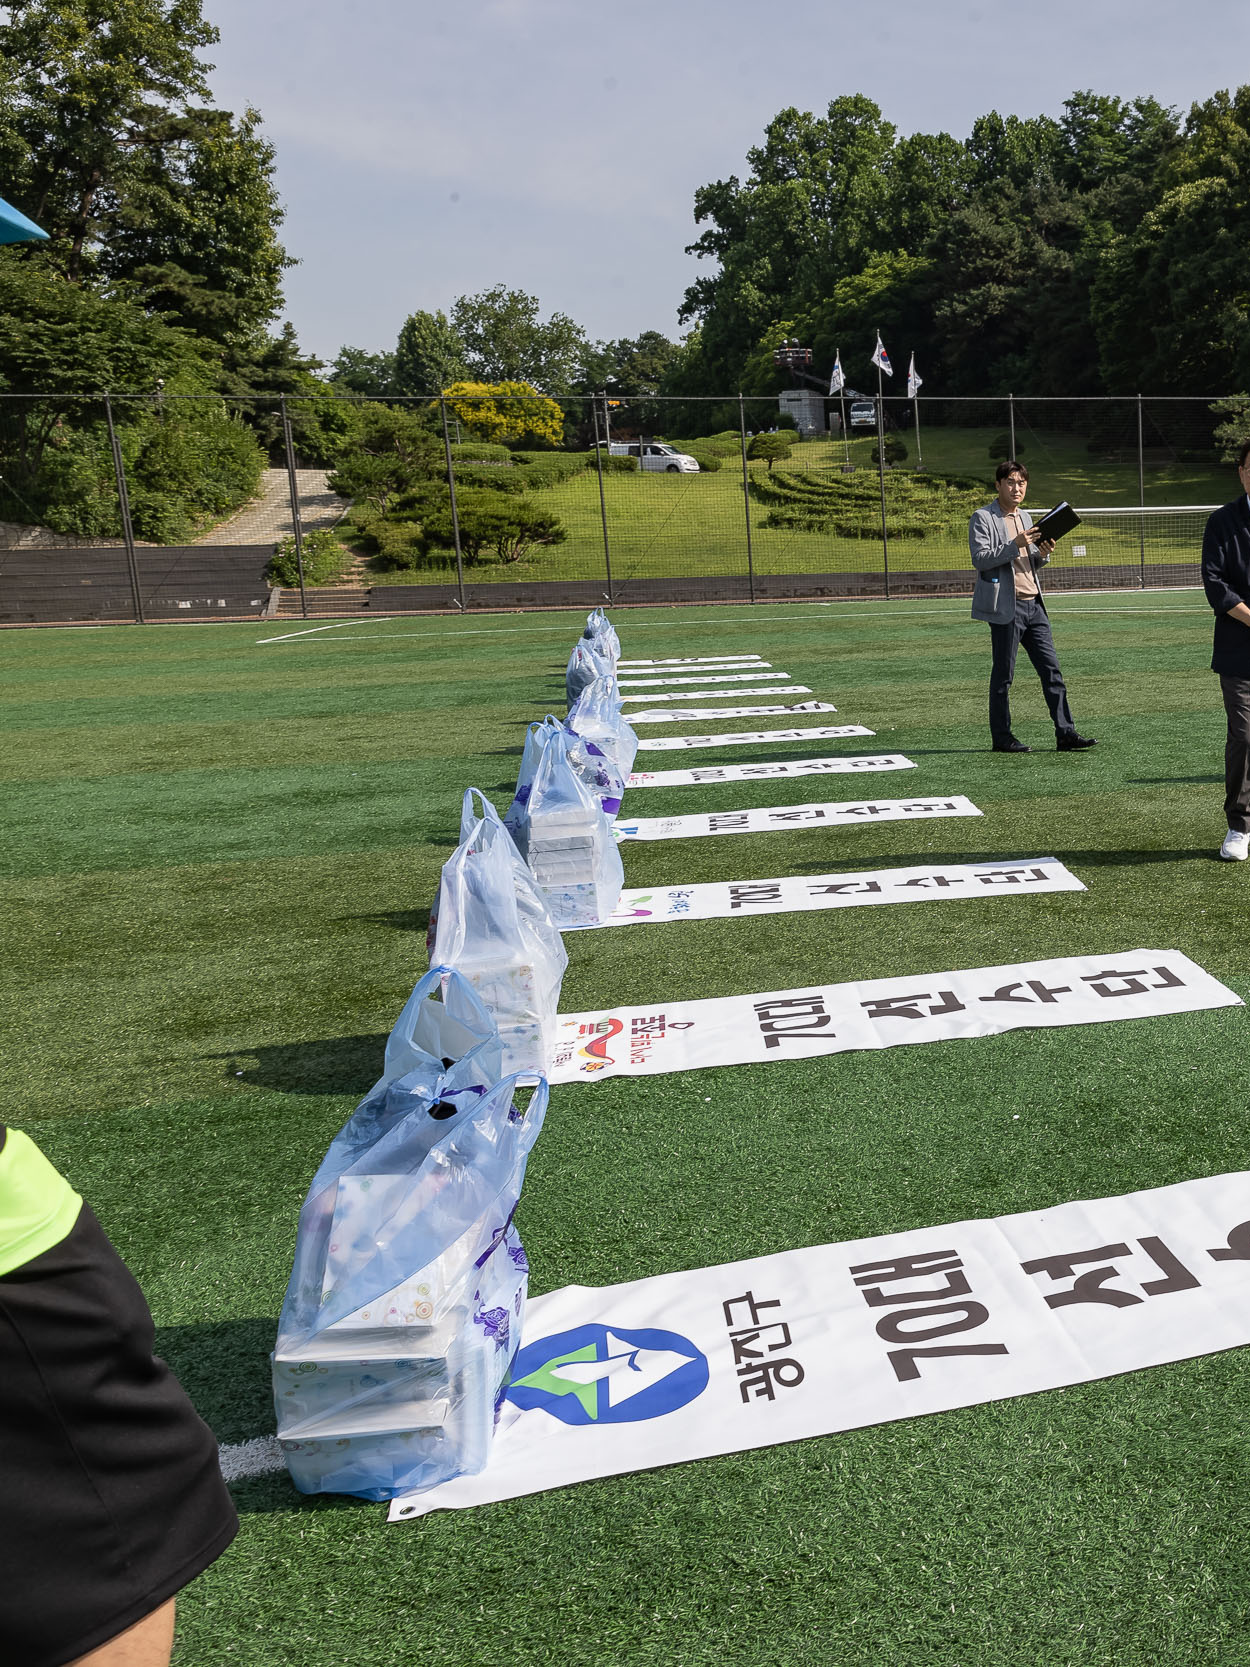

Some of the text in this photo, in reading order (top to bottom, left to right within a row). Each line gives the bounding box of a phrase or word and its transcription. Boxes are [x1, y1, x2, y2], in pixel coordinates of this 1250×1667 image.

[752, 995, 836, 1048] 70대
[722, 1291, 805, 1404] 광진구
[847, 1250, 1010, 1383] 70대
